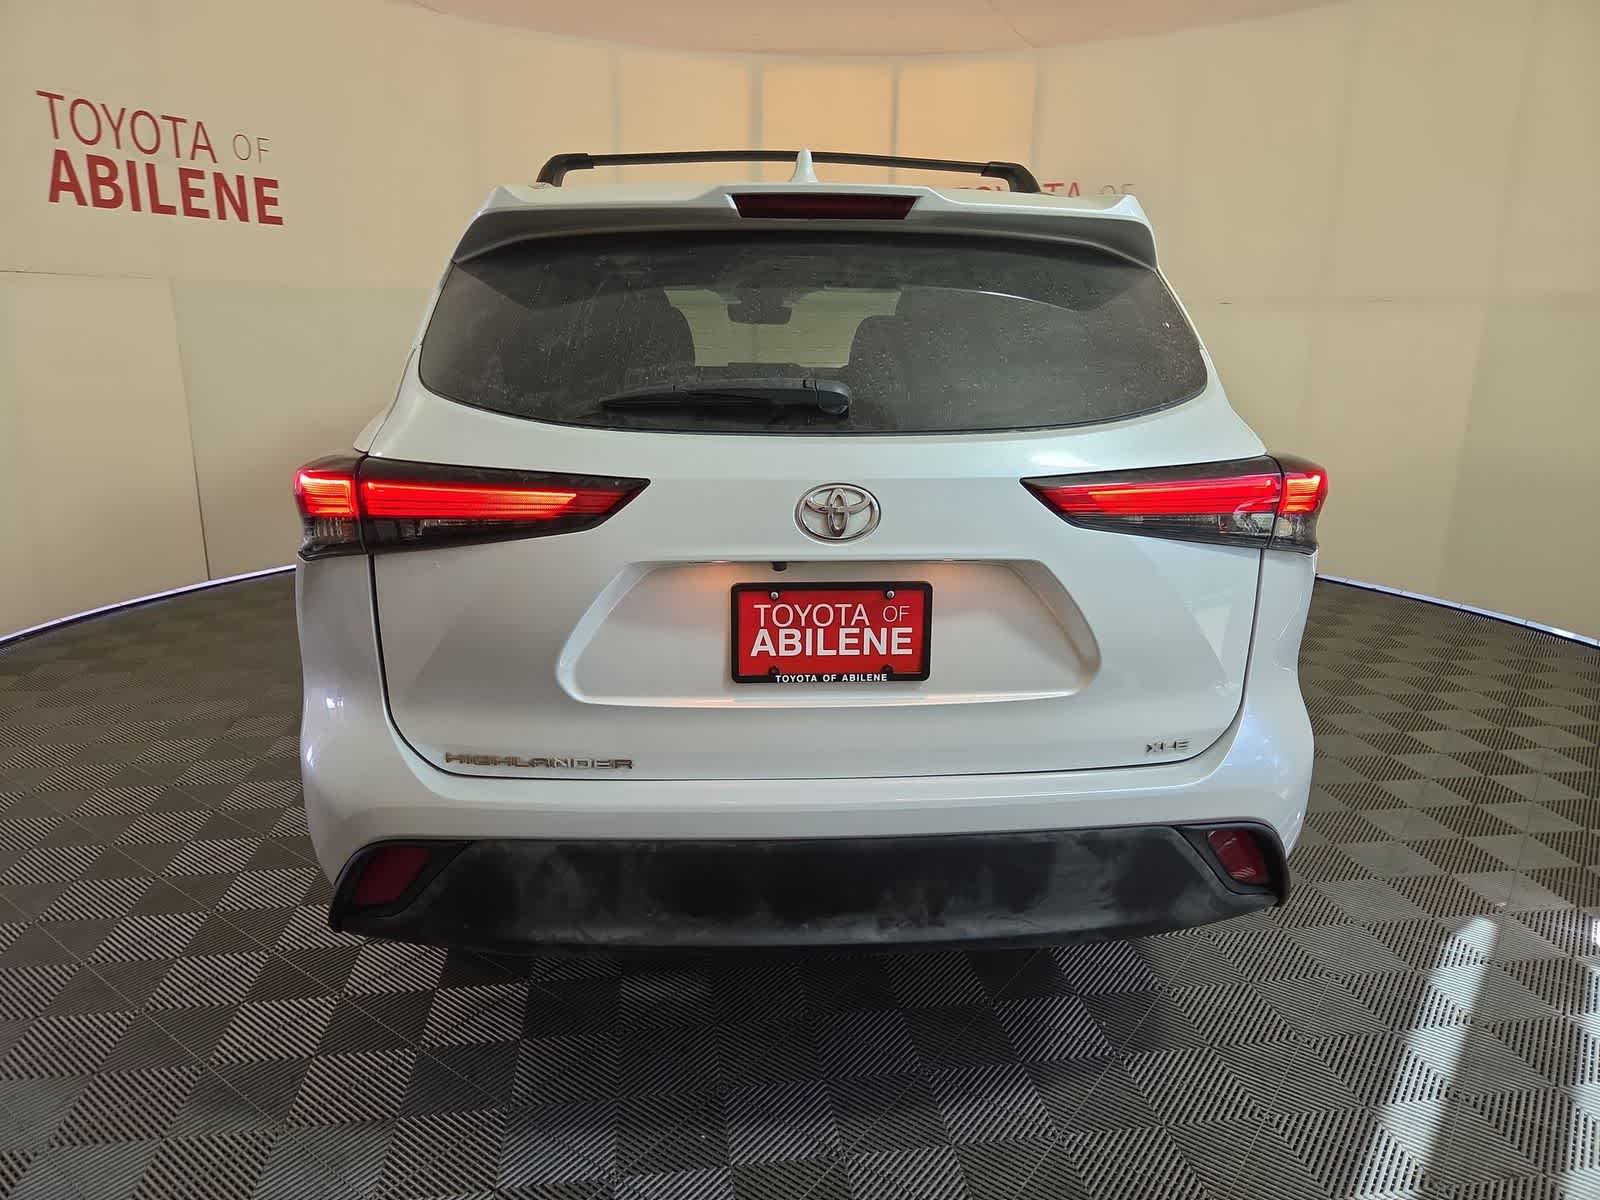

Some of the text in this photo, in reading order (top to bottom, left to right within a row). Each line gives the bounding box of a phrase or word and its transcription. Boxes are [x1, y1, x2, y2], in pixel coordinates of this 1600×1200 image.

[36, 90, 270, 163] TOYOTA OF
[48, 149, 284, 226] ABILENE
[753, 604, 910, 627] TOYOTA OF
[750, 627, 913, 657] ABILENE
[775, 673, 888, 683] TOYOTA OF ABILENE
[1145, 740, 1190, 753] XLE
[445, 752, 633, 770] HIGHLANDER
